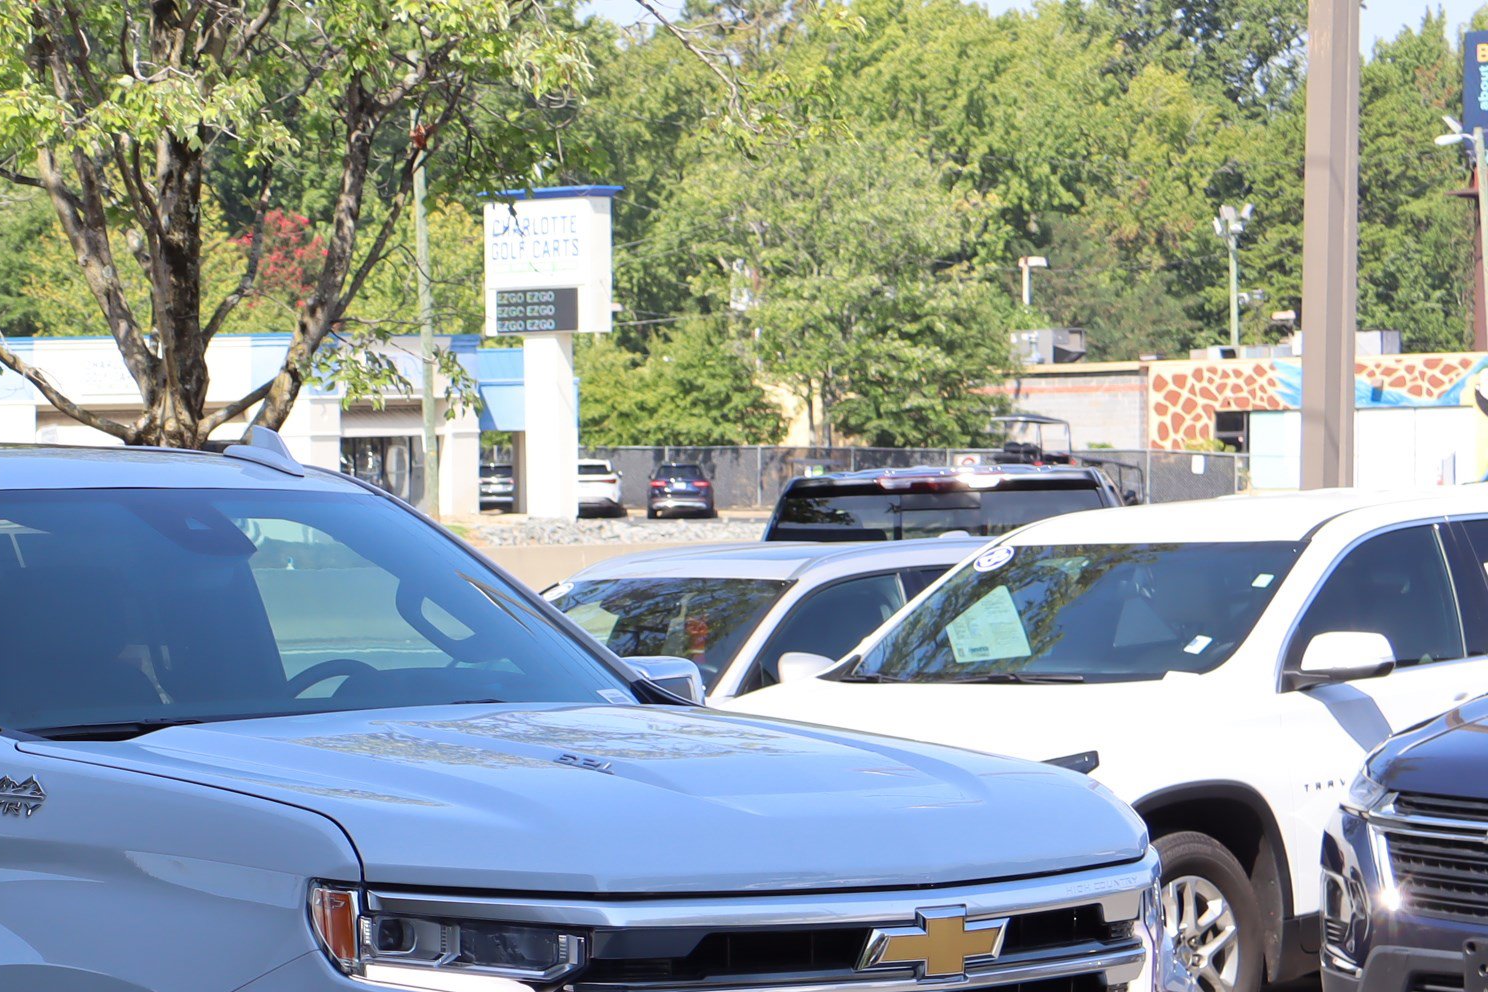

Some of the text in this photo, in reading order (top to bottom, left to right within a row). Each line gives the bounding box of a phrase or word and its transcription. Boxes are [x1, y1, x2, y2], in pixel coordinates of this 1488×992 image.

[492, 215, 577, 237] CHARLOTTE
[491, 238, 579, 260] GOLF CARTS
[526, 291, 555, 303] EZGO
[526, 305, 555, 317] EZGO
[497, 319, 555, 332] EZGO EZGO
